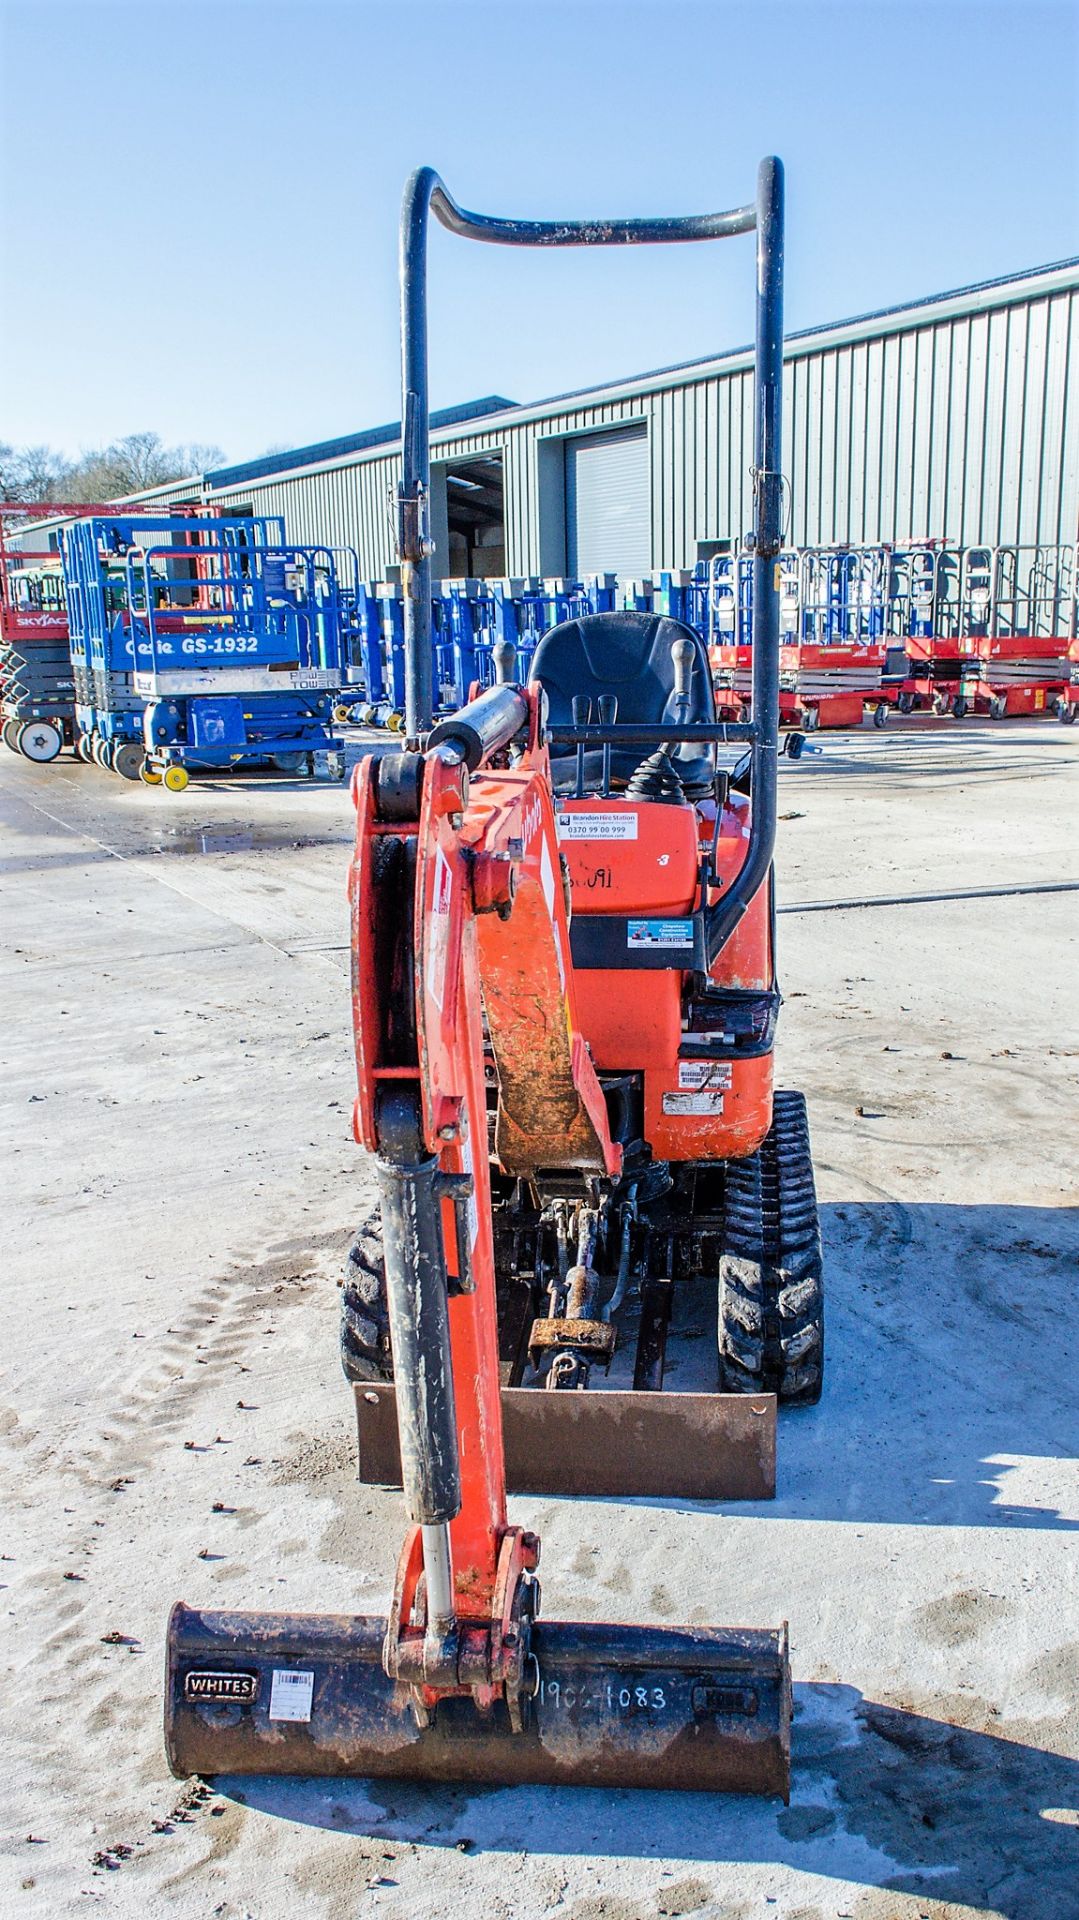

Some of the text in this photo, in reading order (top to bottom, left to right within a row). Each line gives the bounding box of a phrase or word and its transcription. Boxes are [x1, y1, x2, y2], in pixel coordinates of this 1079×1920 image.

[16, 614, 68, 626] SKYJAC
[182, 637, 258, 653] GS-1932
[291, 680, 337, 689] TOWER
[191, 1679, 250, 1693] WHITES
